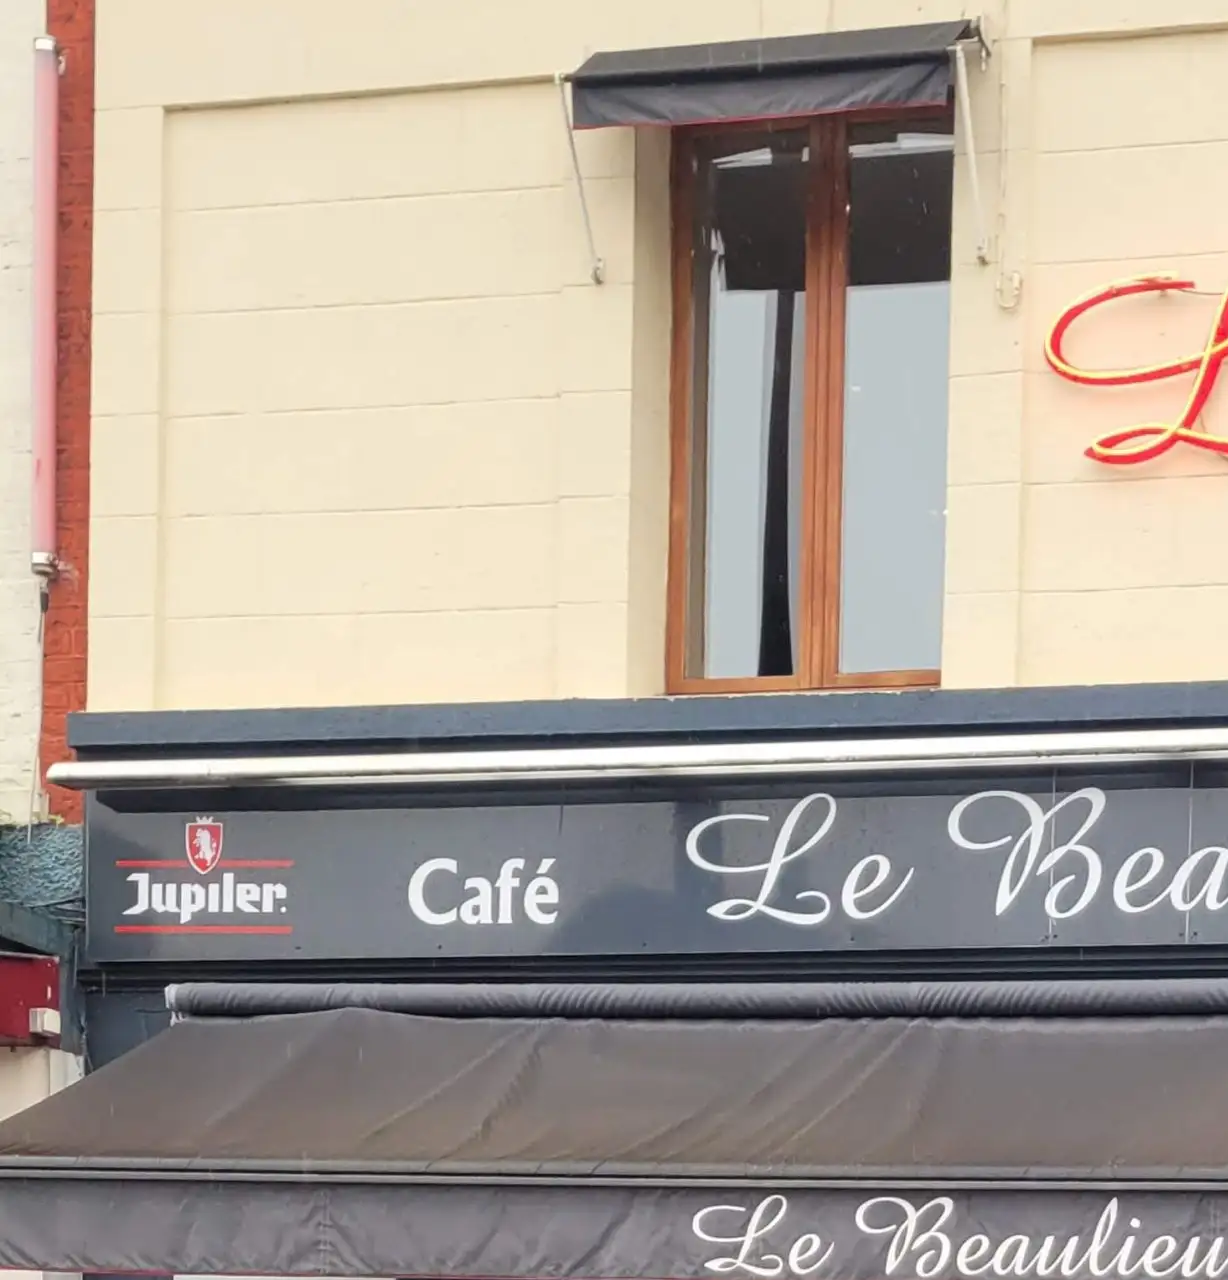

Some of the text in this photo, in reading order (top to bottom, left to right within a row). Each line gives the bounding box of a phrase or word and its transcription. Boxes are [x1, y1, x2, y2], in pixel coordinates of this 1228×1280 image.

[407, 857, 560, 926] Café
[685, 793, 914, 926] Le
[692, 1194, 835, 1277] Le
